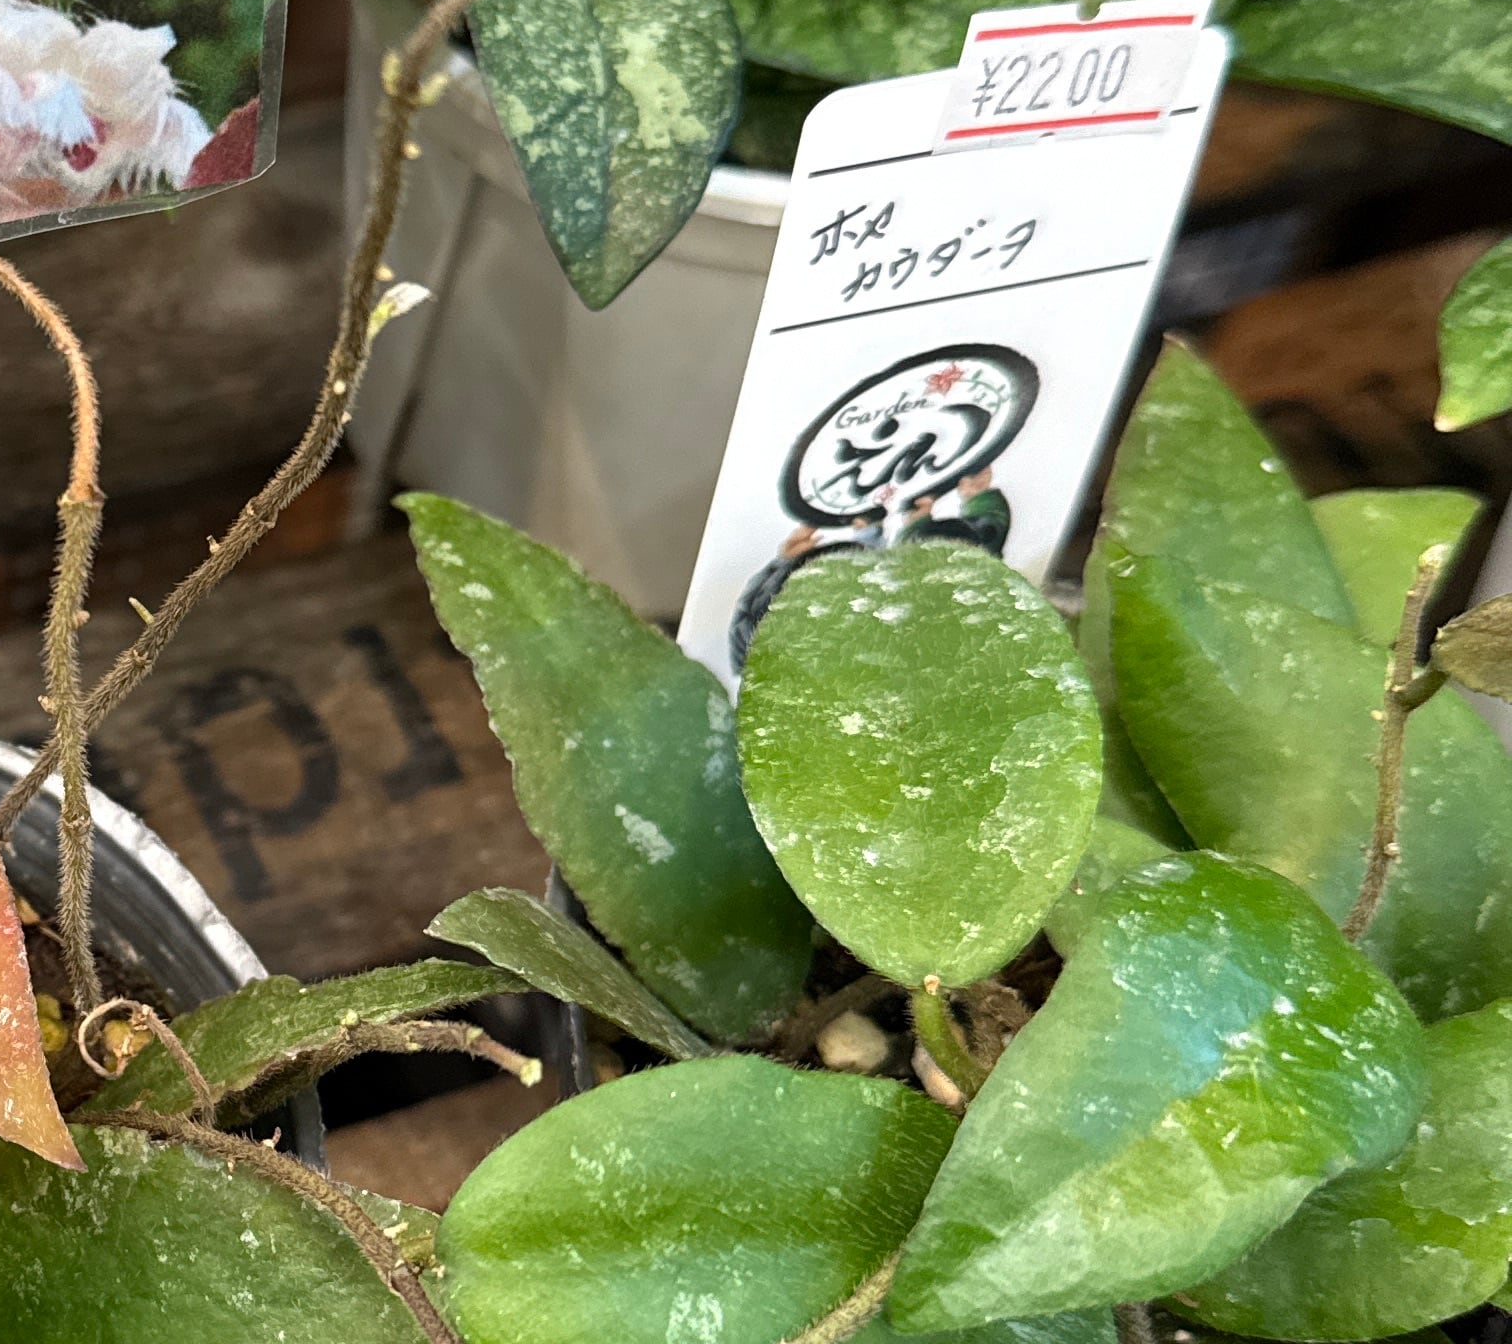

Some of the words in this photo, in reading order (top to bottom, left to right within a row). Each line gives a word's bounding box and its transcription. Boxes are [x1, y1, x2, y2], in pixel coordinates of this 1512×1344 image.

[971, 43, 1133, 118] ¥2200
[809, 201, 896, 266] ホヤ
[834, 391, 931, 430] Garden
